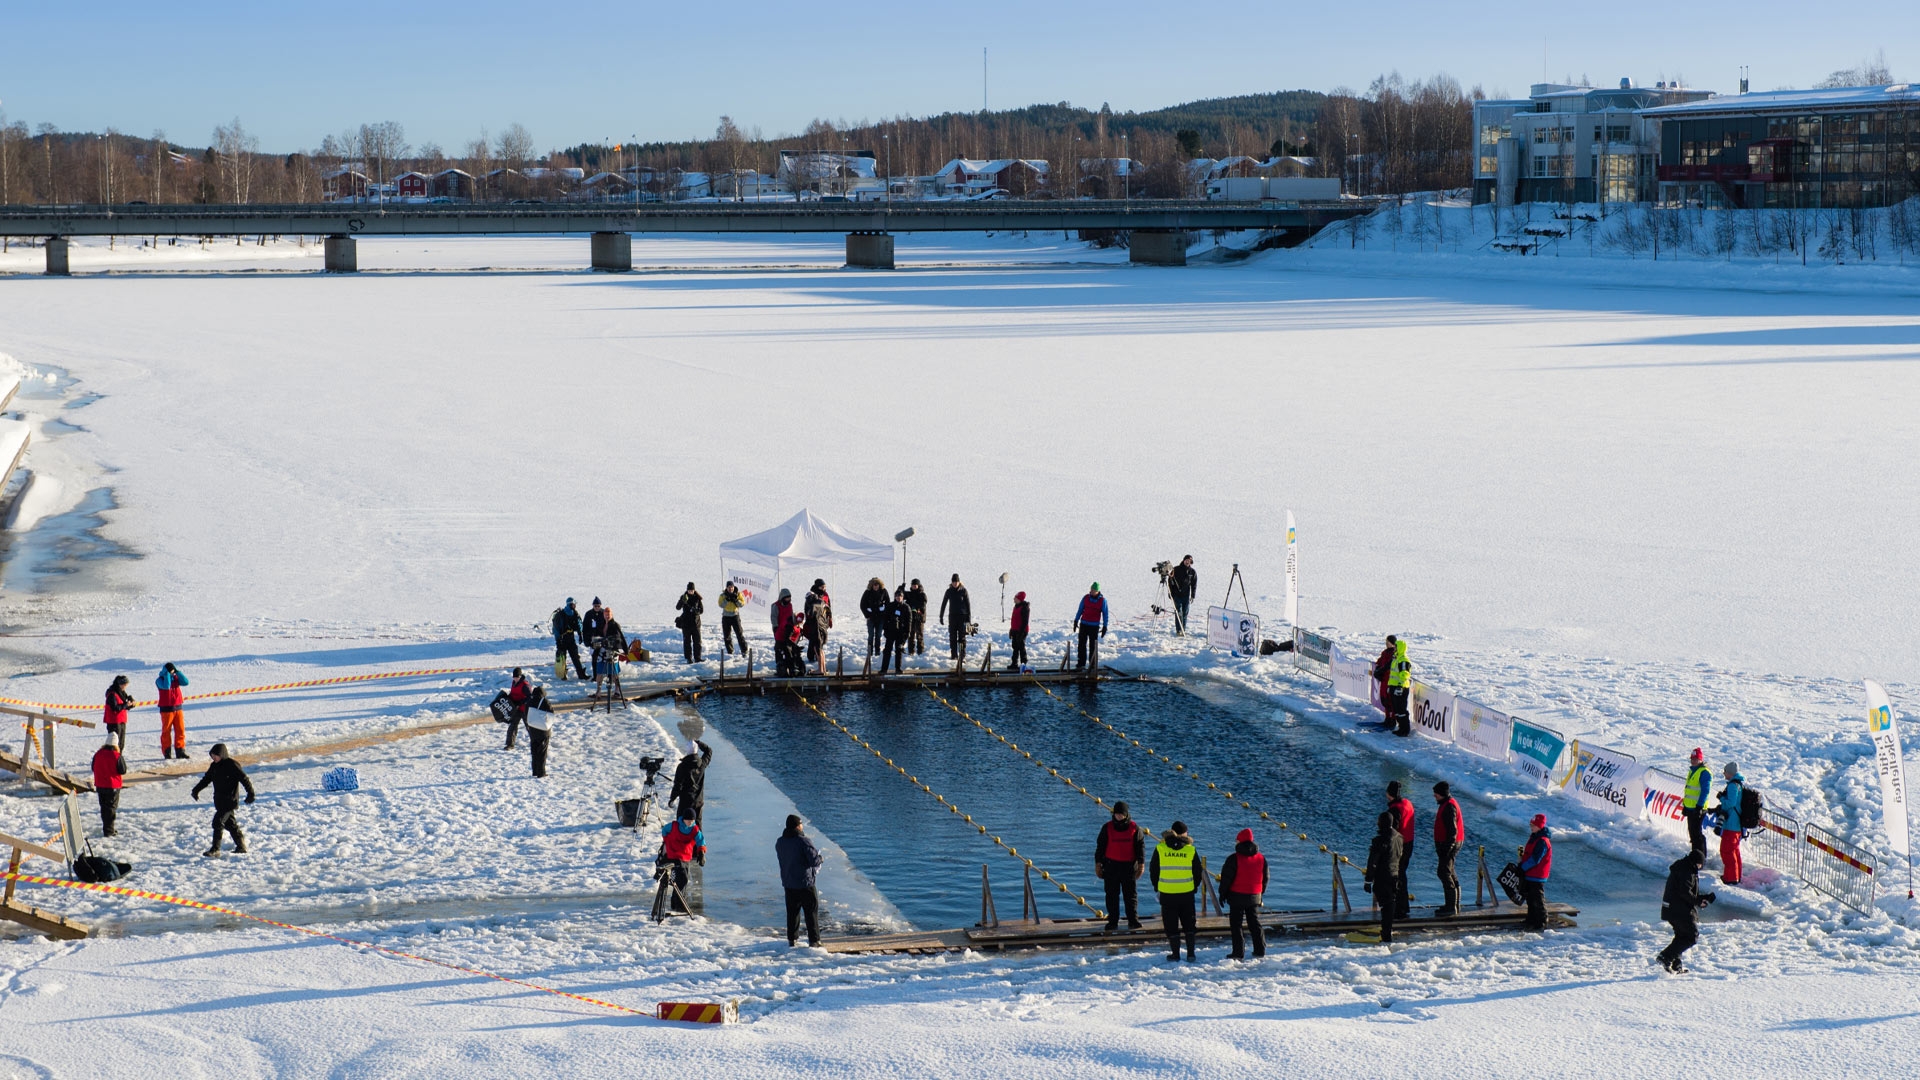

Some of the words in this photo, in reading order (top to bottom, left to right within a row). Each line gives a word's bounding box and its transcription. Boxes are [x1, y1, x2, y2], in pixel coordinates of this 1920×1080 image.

[500, 697, 513, 712] clas
[1589, 757, 1621, 779] Fritid
[1582, 774, 1627, 807] Skellefteå
